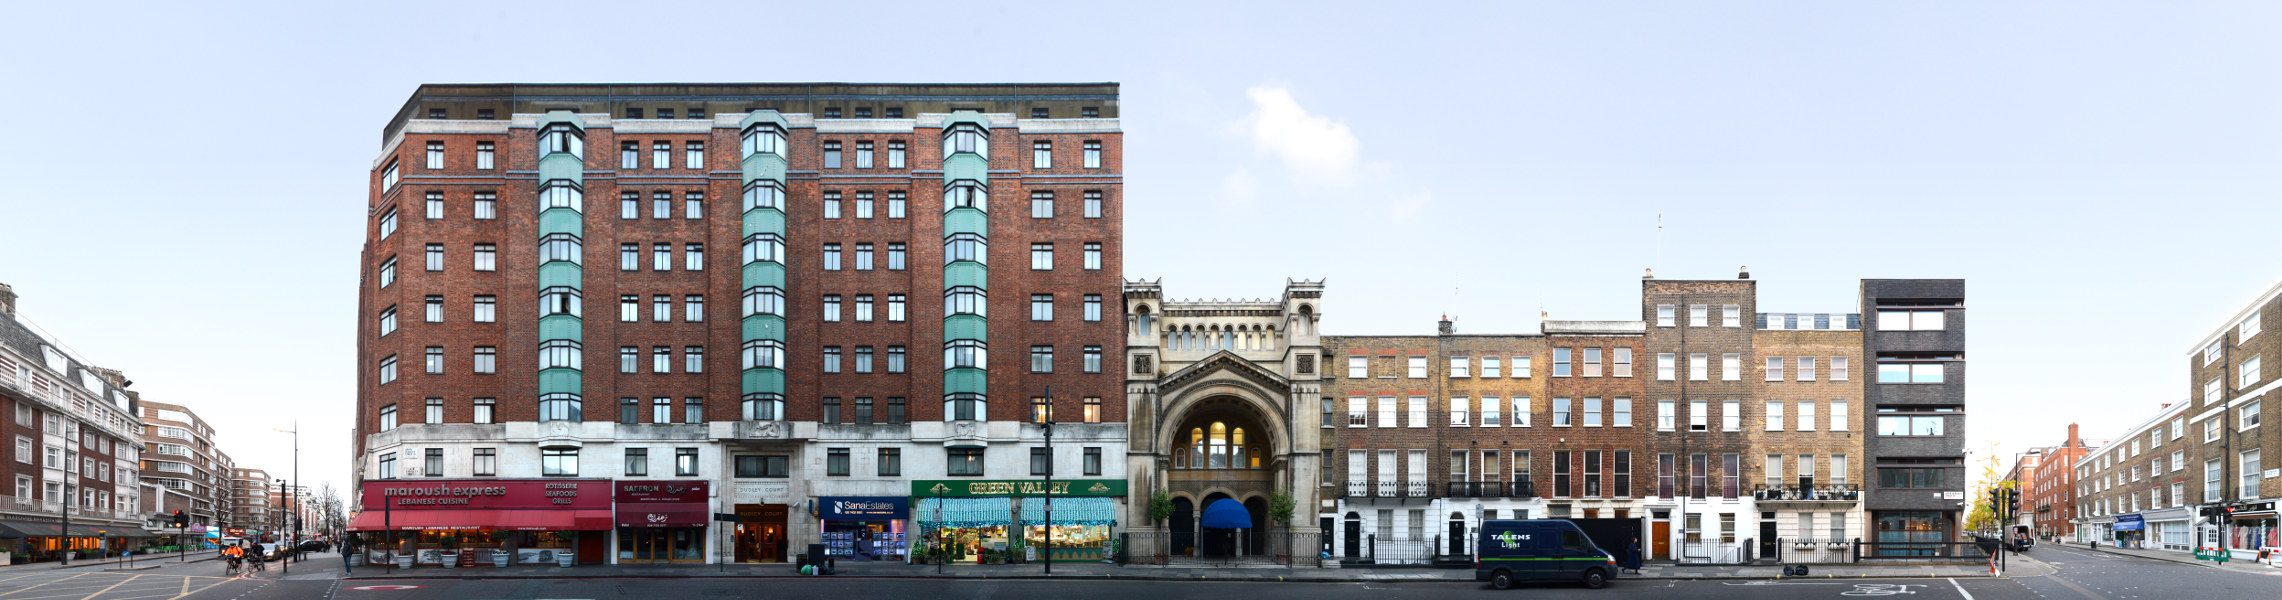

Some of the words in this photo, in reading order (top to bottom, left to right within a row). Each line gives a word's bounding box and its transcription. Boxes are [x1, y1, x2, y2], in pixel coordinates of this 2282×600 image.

[384, 484, 450, 496] maroush
[453, 486, 506, 498] express
[969, 482, 1015, 494] GREEN
[844, 500, 894, 510] SanaEstates
[1501, 541, 1520, 549] Light
